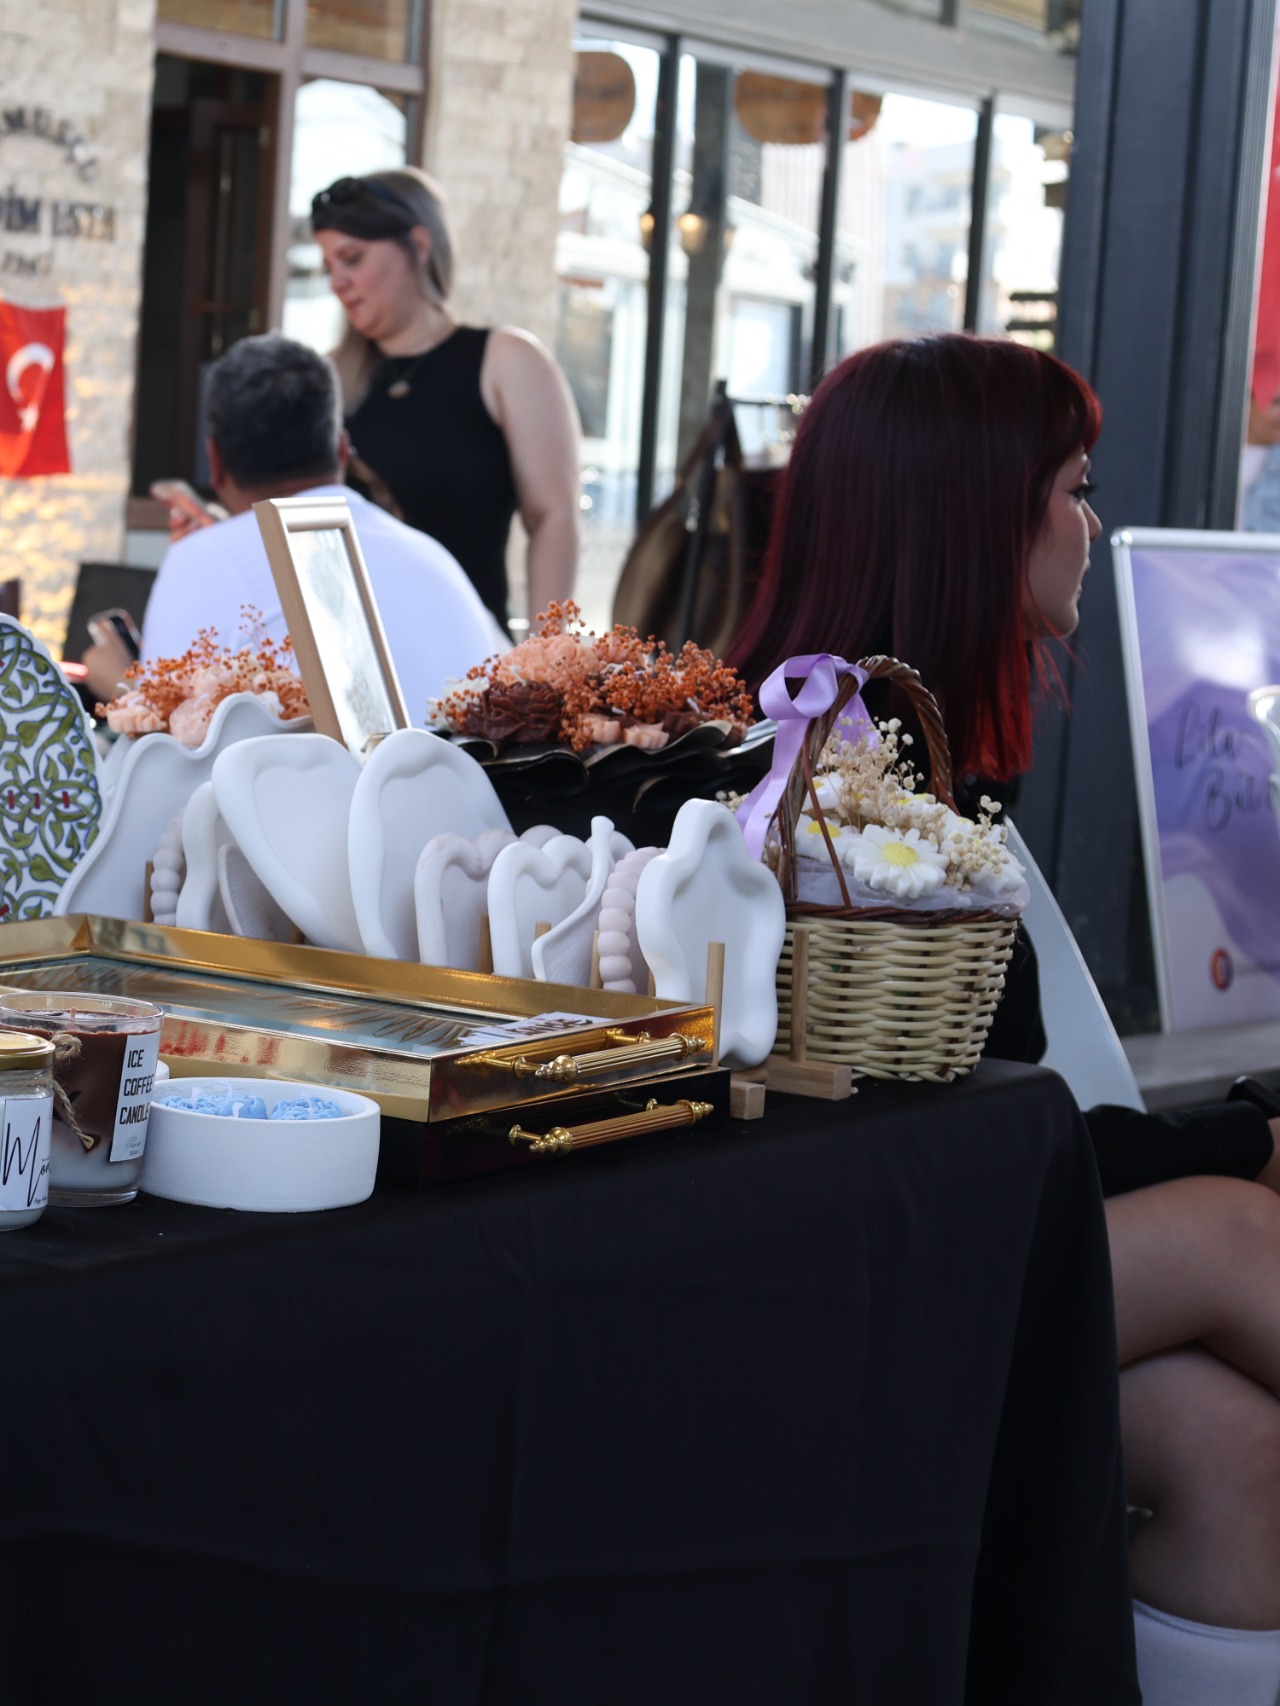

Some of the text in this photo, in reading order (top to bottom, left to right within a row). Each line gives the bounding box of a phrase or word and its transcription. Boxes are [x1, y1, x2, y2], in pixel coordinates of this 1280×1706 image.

[127, 1049, 145, 1069] ICE
[123, 1074, 154, 1097] COFFEE
[119, 1102, 150, 1125] CANDLE
